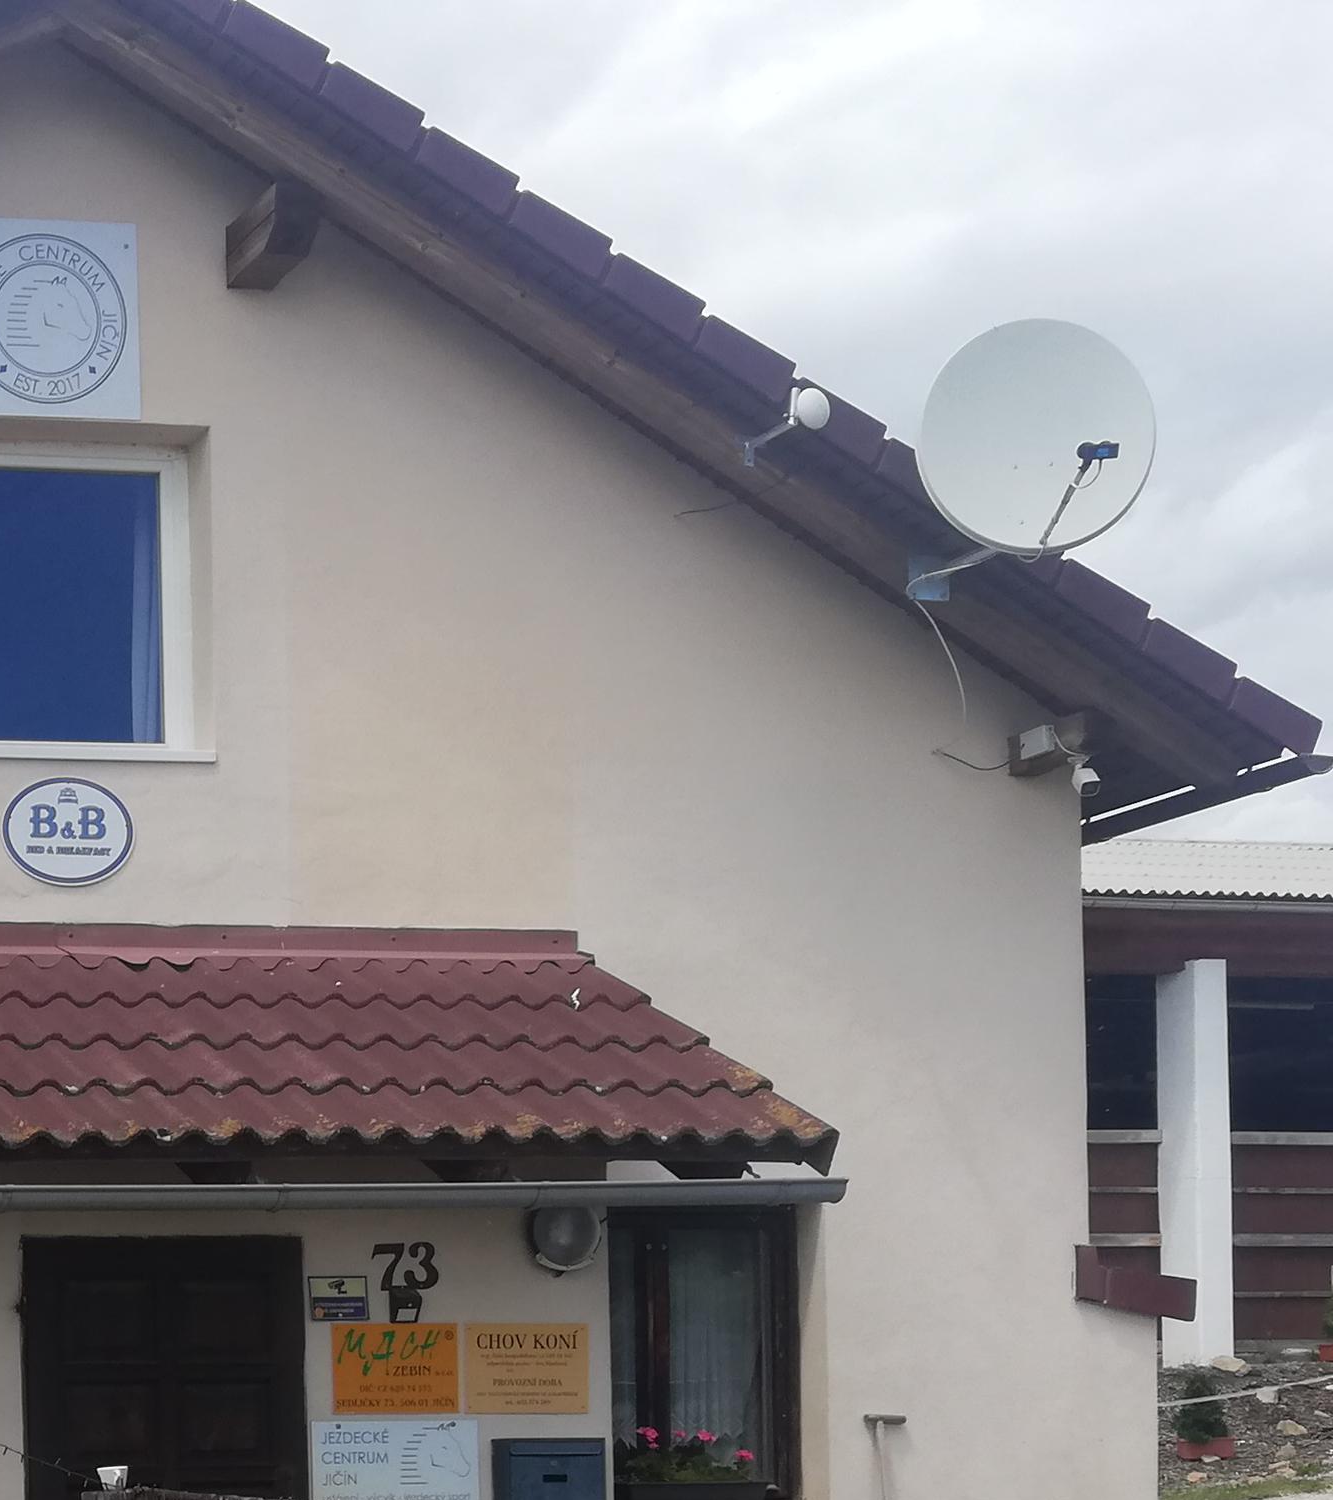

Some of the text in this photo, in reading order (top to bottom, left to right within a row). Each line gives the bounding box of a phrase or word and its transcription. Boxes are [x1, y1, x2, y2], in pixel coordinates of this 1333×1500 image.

[18, 243, 106, 293] CENTRUM
[95, 309, 118, 362] JIČÍN
[12, 372, 83, 397] EST. 2017
[29, 803, 107, 840] B&B
[371, 1241, 439, 1292] 73
[476, 1329, 580, 1350] CHOV KONÍ
[321, 1428, 389, 1445] JEZDECKÉ
[321, 1451, 389, 1465] CENTRUM
[322, 1469, 358, 1487] JIČÍN
